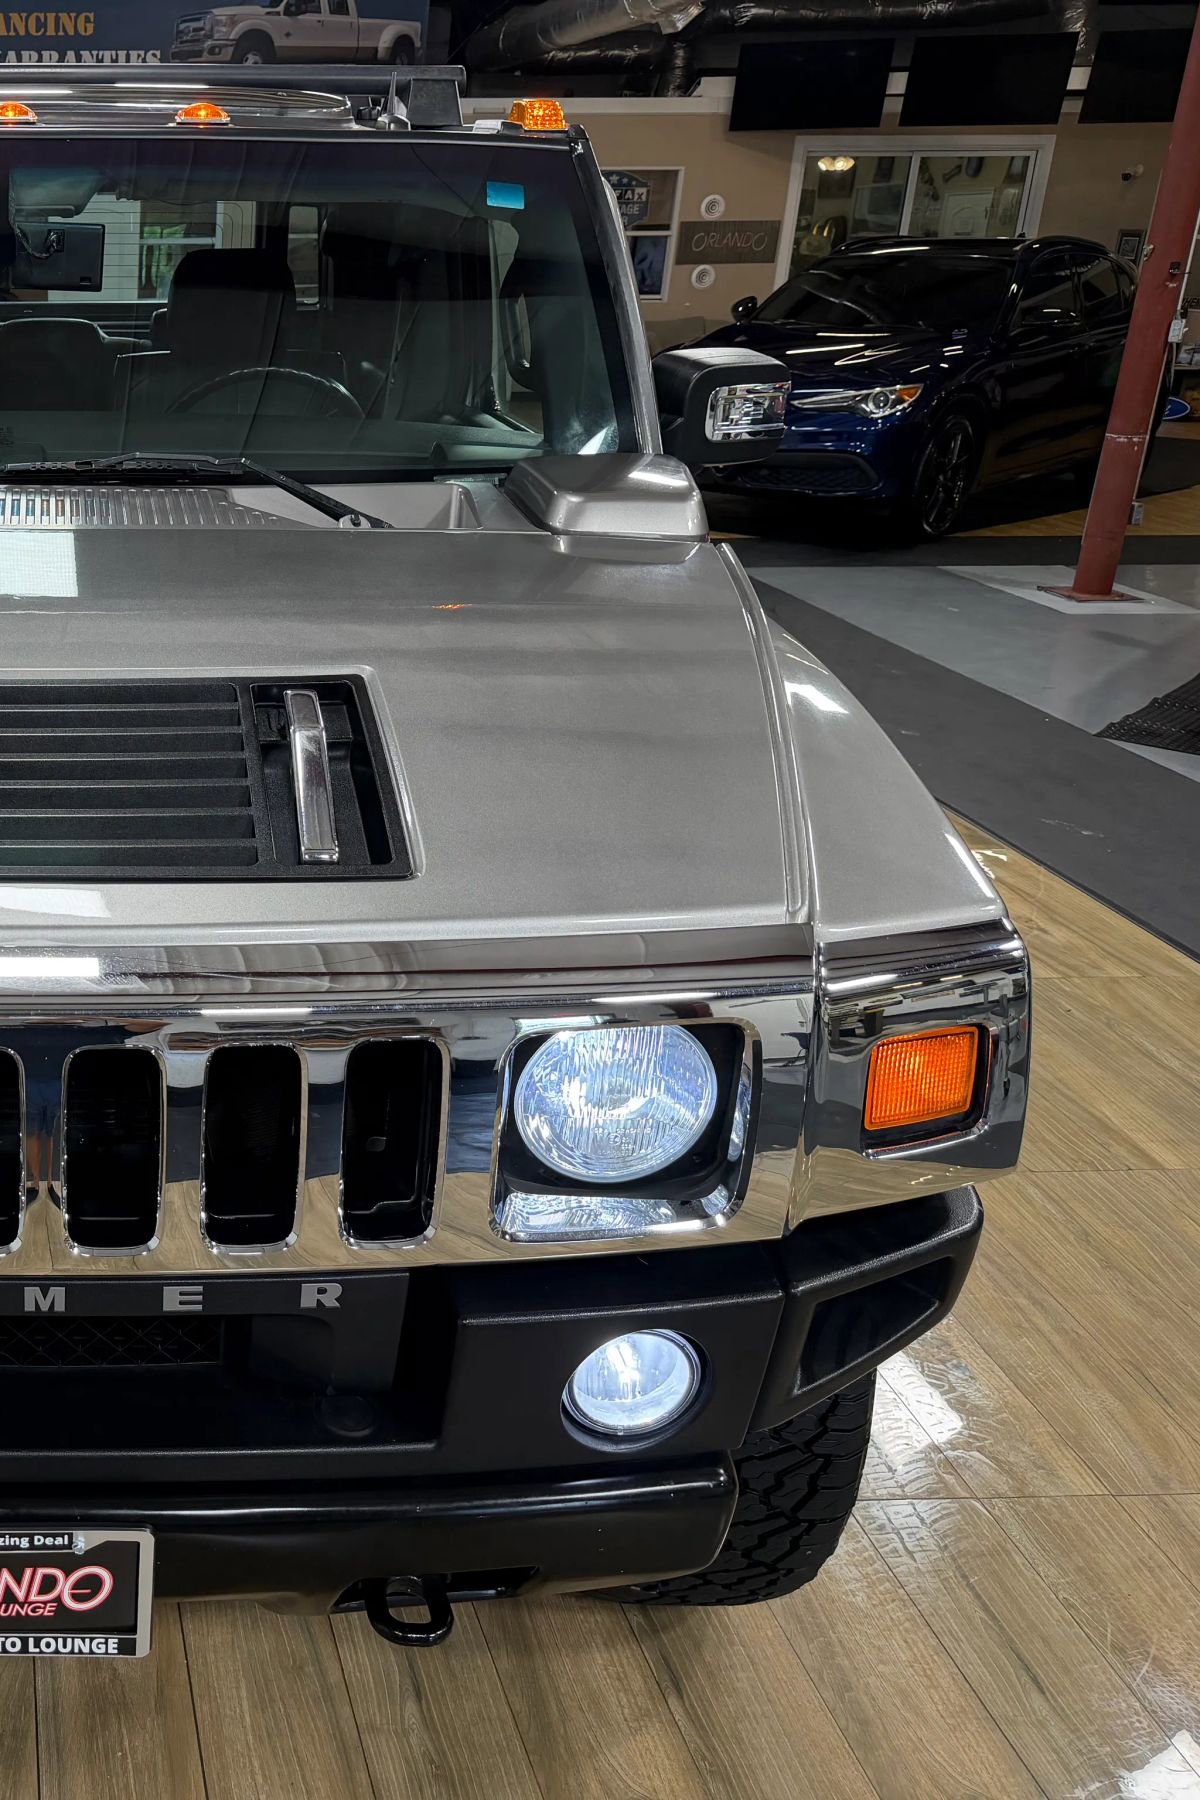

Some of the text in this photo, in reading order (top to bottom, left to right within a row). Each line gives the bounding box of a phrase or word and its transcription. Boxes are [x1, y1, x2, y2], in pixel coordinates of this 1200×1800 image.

[692, 232, 768, 252] ORLANDO
[34, 1535, 69, 1546] Deal
[28, 1637, 118, 1654] LOUNGE
